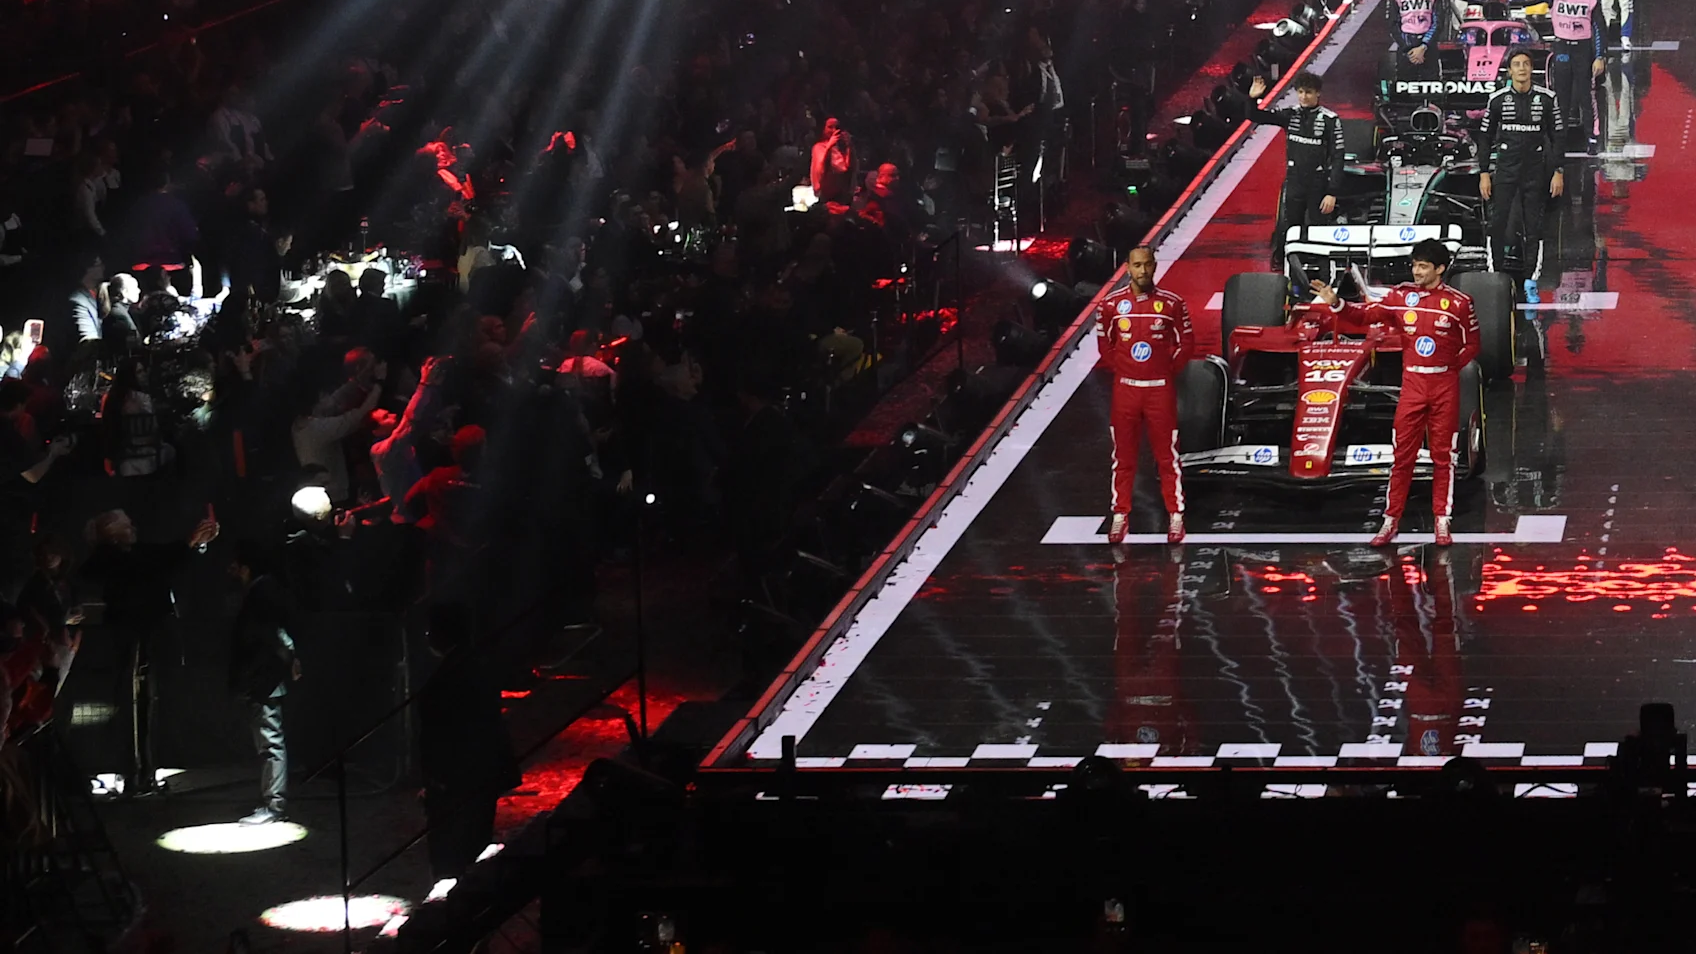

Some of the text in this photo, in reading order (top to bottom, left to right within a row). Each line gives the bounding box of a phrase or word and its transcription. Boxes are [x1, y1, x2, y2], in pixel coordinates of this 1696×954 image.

[1401, 0, 1432, 12] BWT
[1557, 1, 1590, 16] BWT
[1396, 81, 1497, 94] PETRONAS
[1502, 123, 1541, 132] PETRONAS
[1288, 134, 1322, 145] PETRONAS
[1133, 342, 1151, 361] hp
[1417, 336, 1434, 356] hp
[1304, 370, 1346, 382] 16
